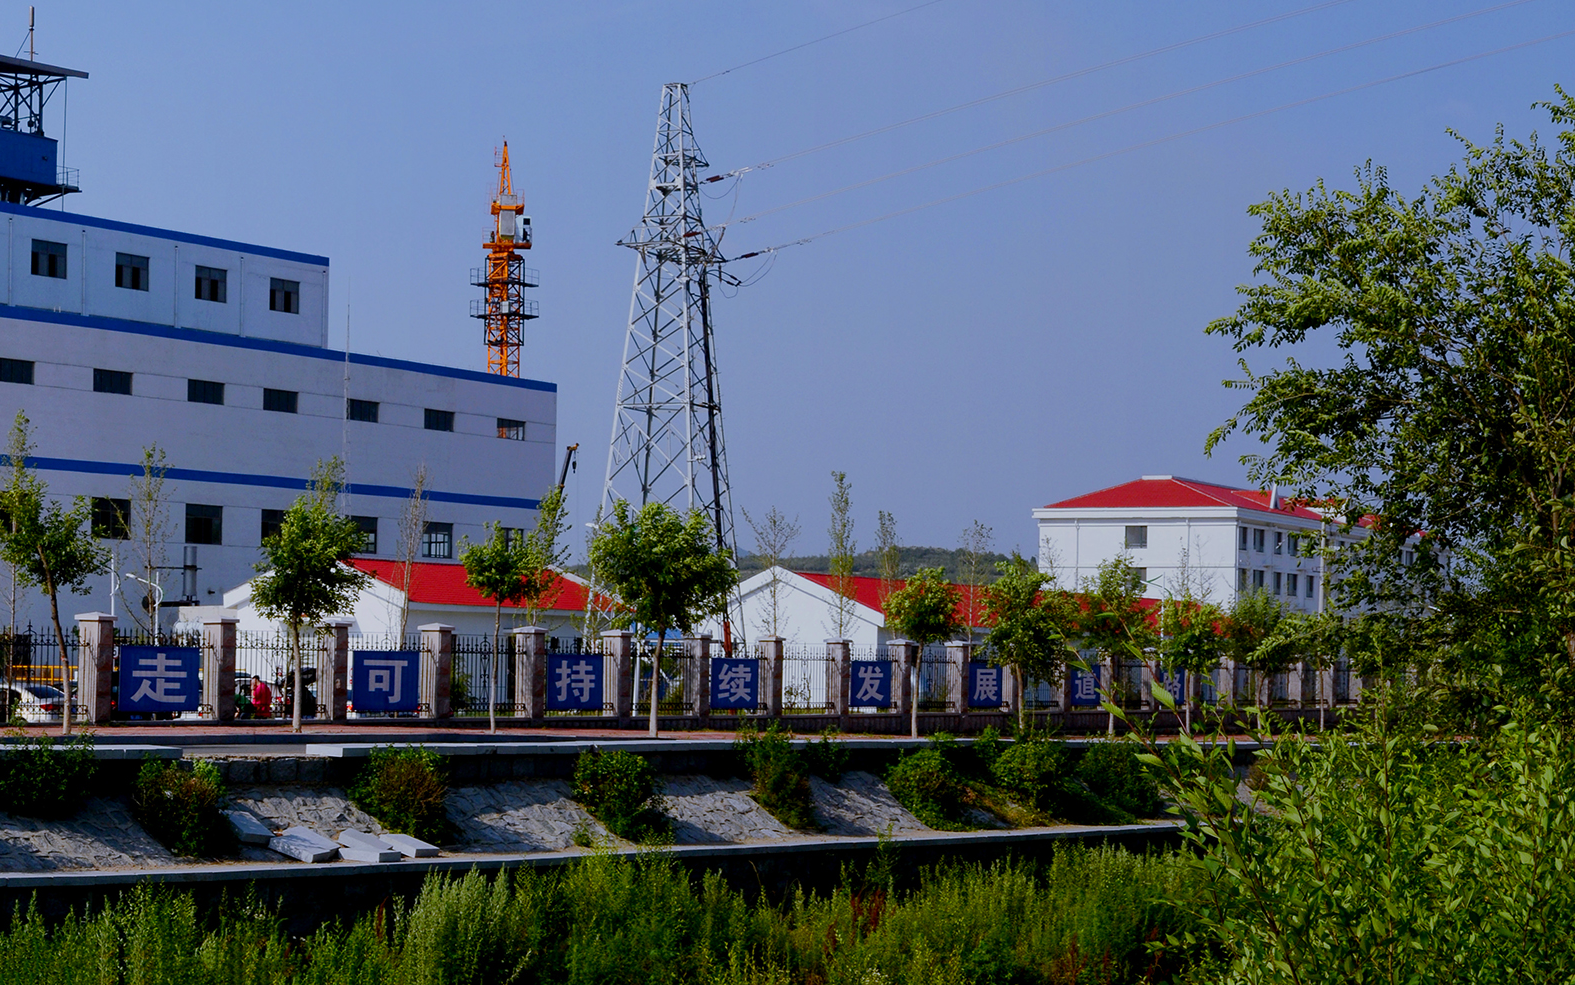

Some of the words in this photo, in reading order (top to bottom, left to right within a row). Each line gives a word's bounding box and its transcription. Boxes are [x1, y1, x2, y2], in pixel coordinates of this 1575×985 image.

[132, 653, 189, 704] 走
[366, 659, 410, 703] 可
[556, 659, 596, 704] 持
[718, 663, 755, 702] 续
[856, 666, 885, 702] 发
[973, 667, 998, 700] 展
[1075, 670, 1097, 700] 道
